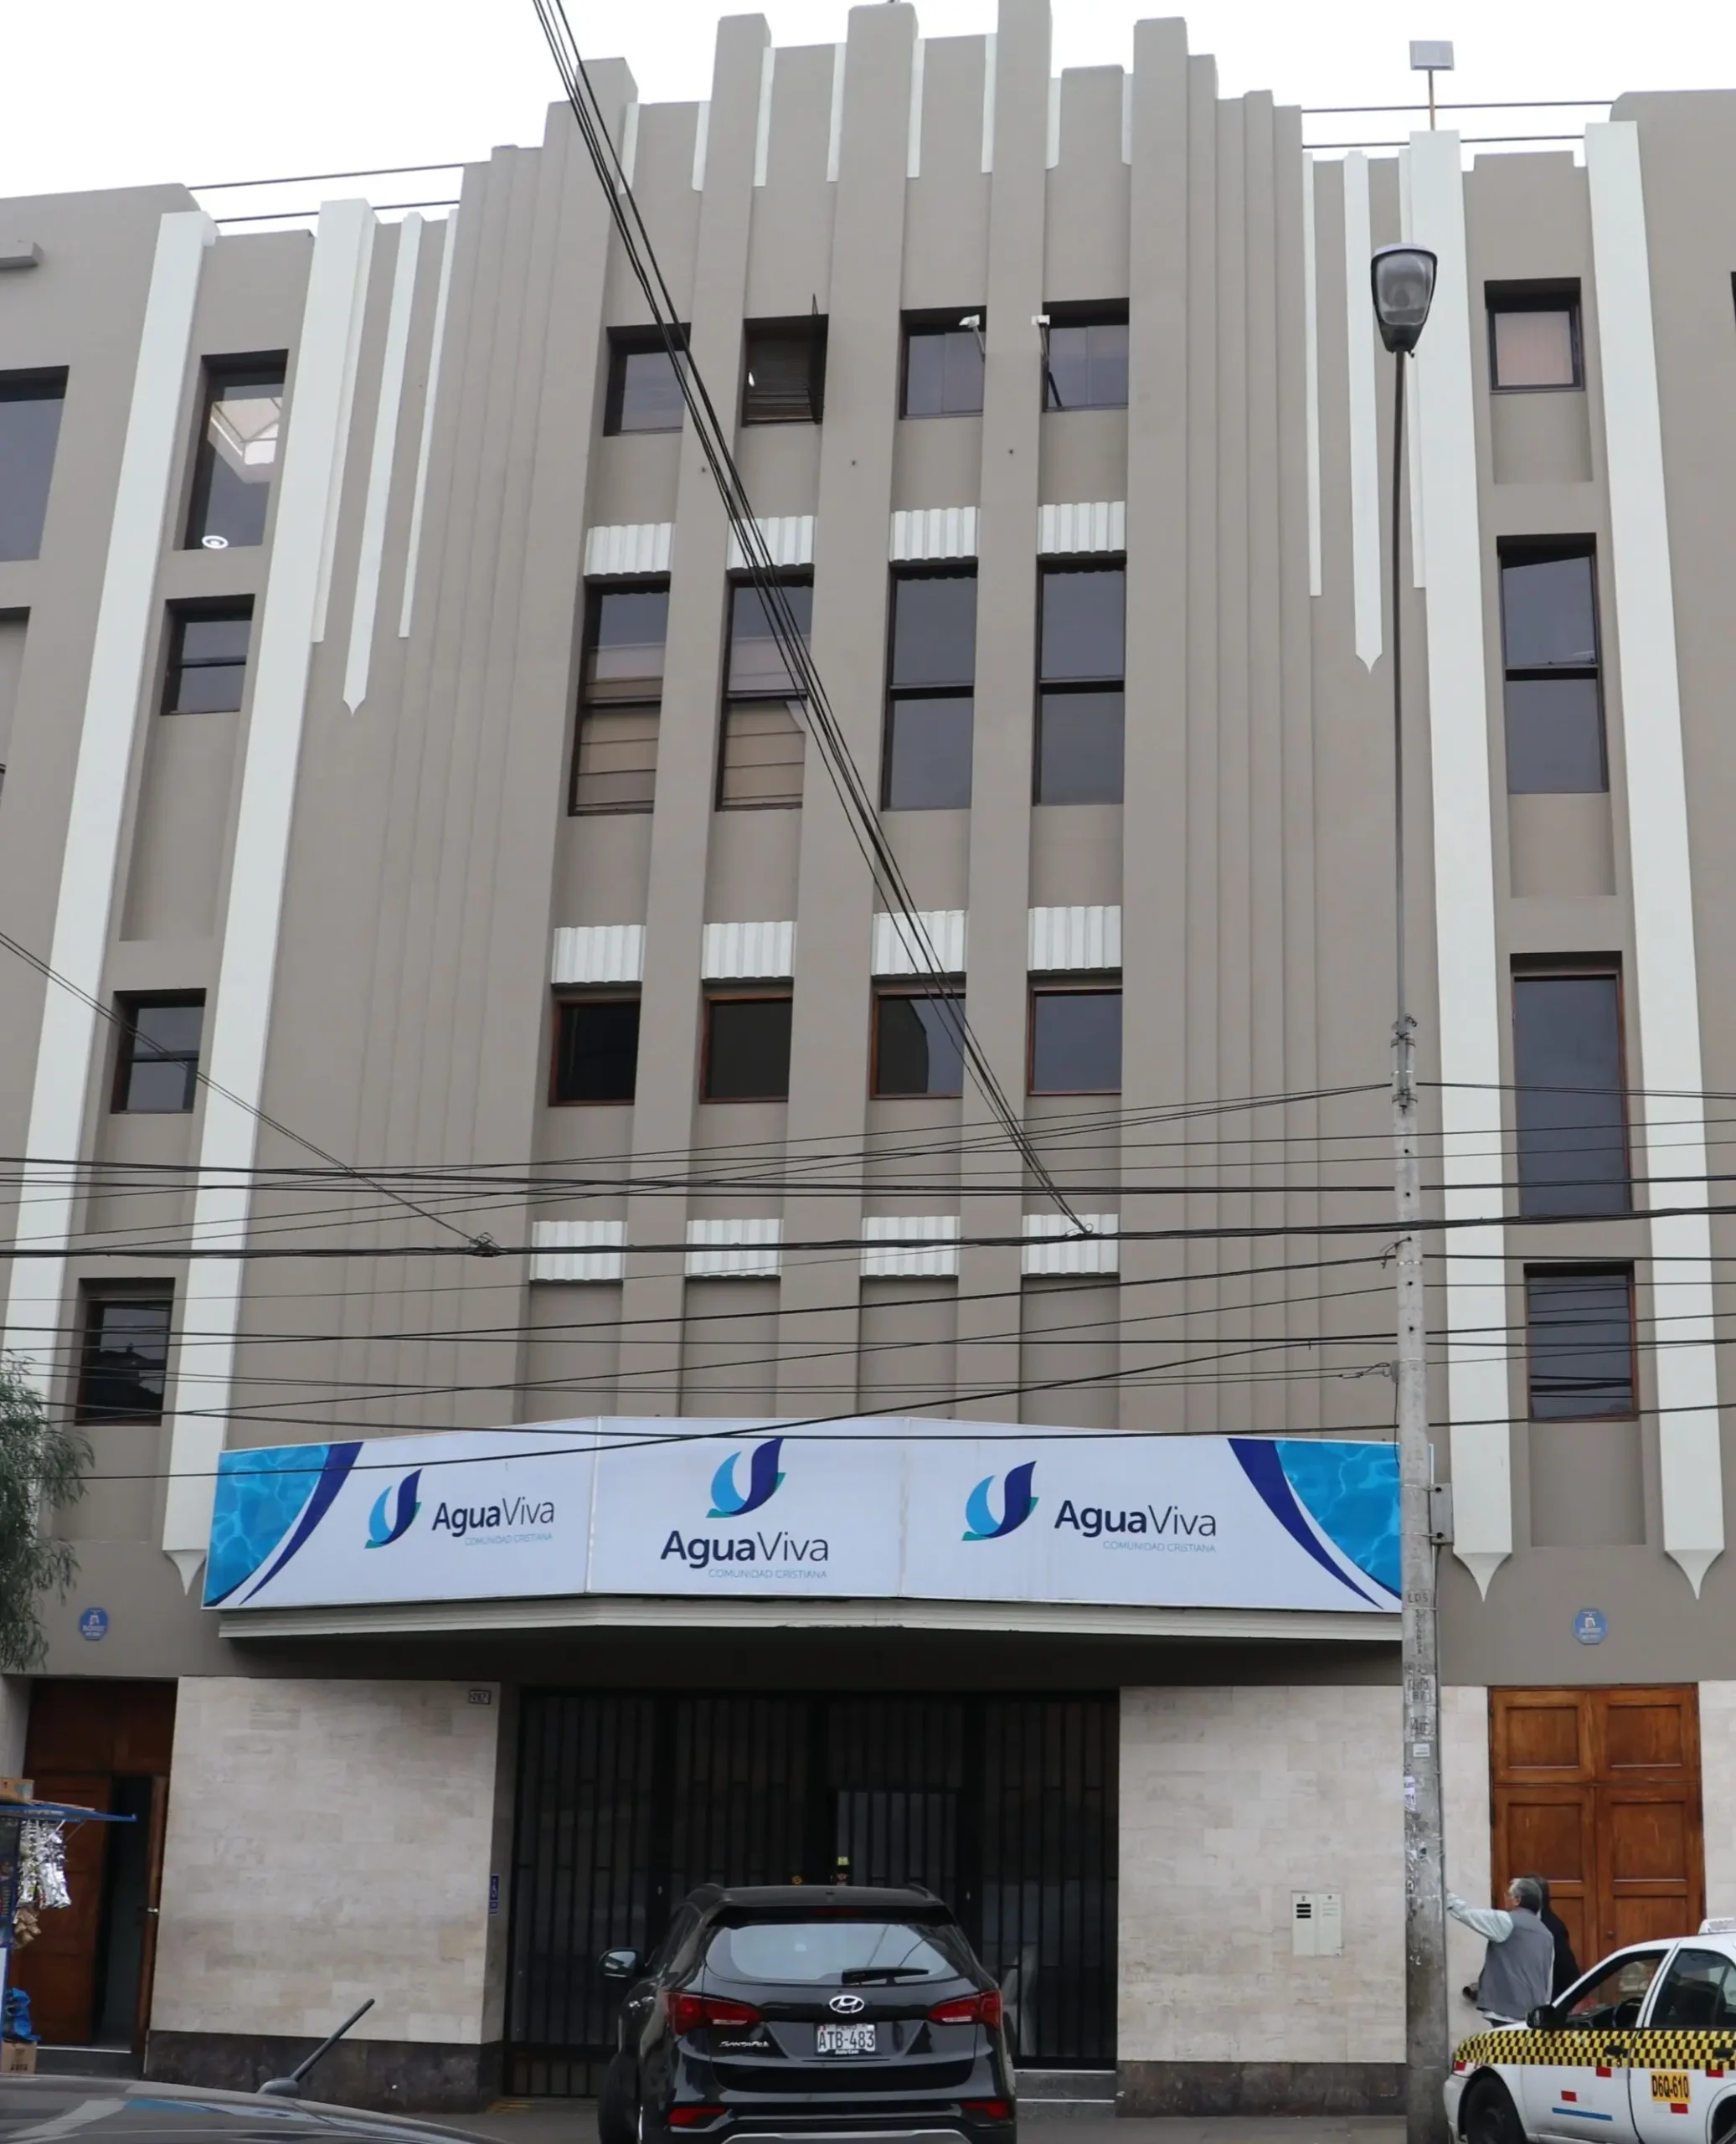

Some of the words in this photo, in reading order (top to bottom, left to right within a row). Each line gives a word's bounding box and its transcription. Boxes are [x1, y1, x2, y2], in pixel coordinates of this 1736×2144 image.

[431, 1496, 554, 1538] AguaViva
[1054, 1499, 1217, 1538] AguaViva
[465, 1535, 513, 1546] COMUNIDAD
[514, 1533, 553, 1544] CRISTIANA
[660, 1529, 828, 1569] AguaViva
[1103, 1541, 1165, 1552] COMUNIDAD
[1167, 1543, 1216, 1553] CRISTIANA
[708, 1569, 773, 1579] COMUNIDAD
[775, 1569, 827, 1579] CRISTIANA
[819, 2031, 874, 2049] ATB-483
[1651, 2075, 1689, 2099] D6Q-610
